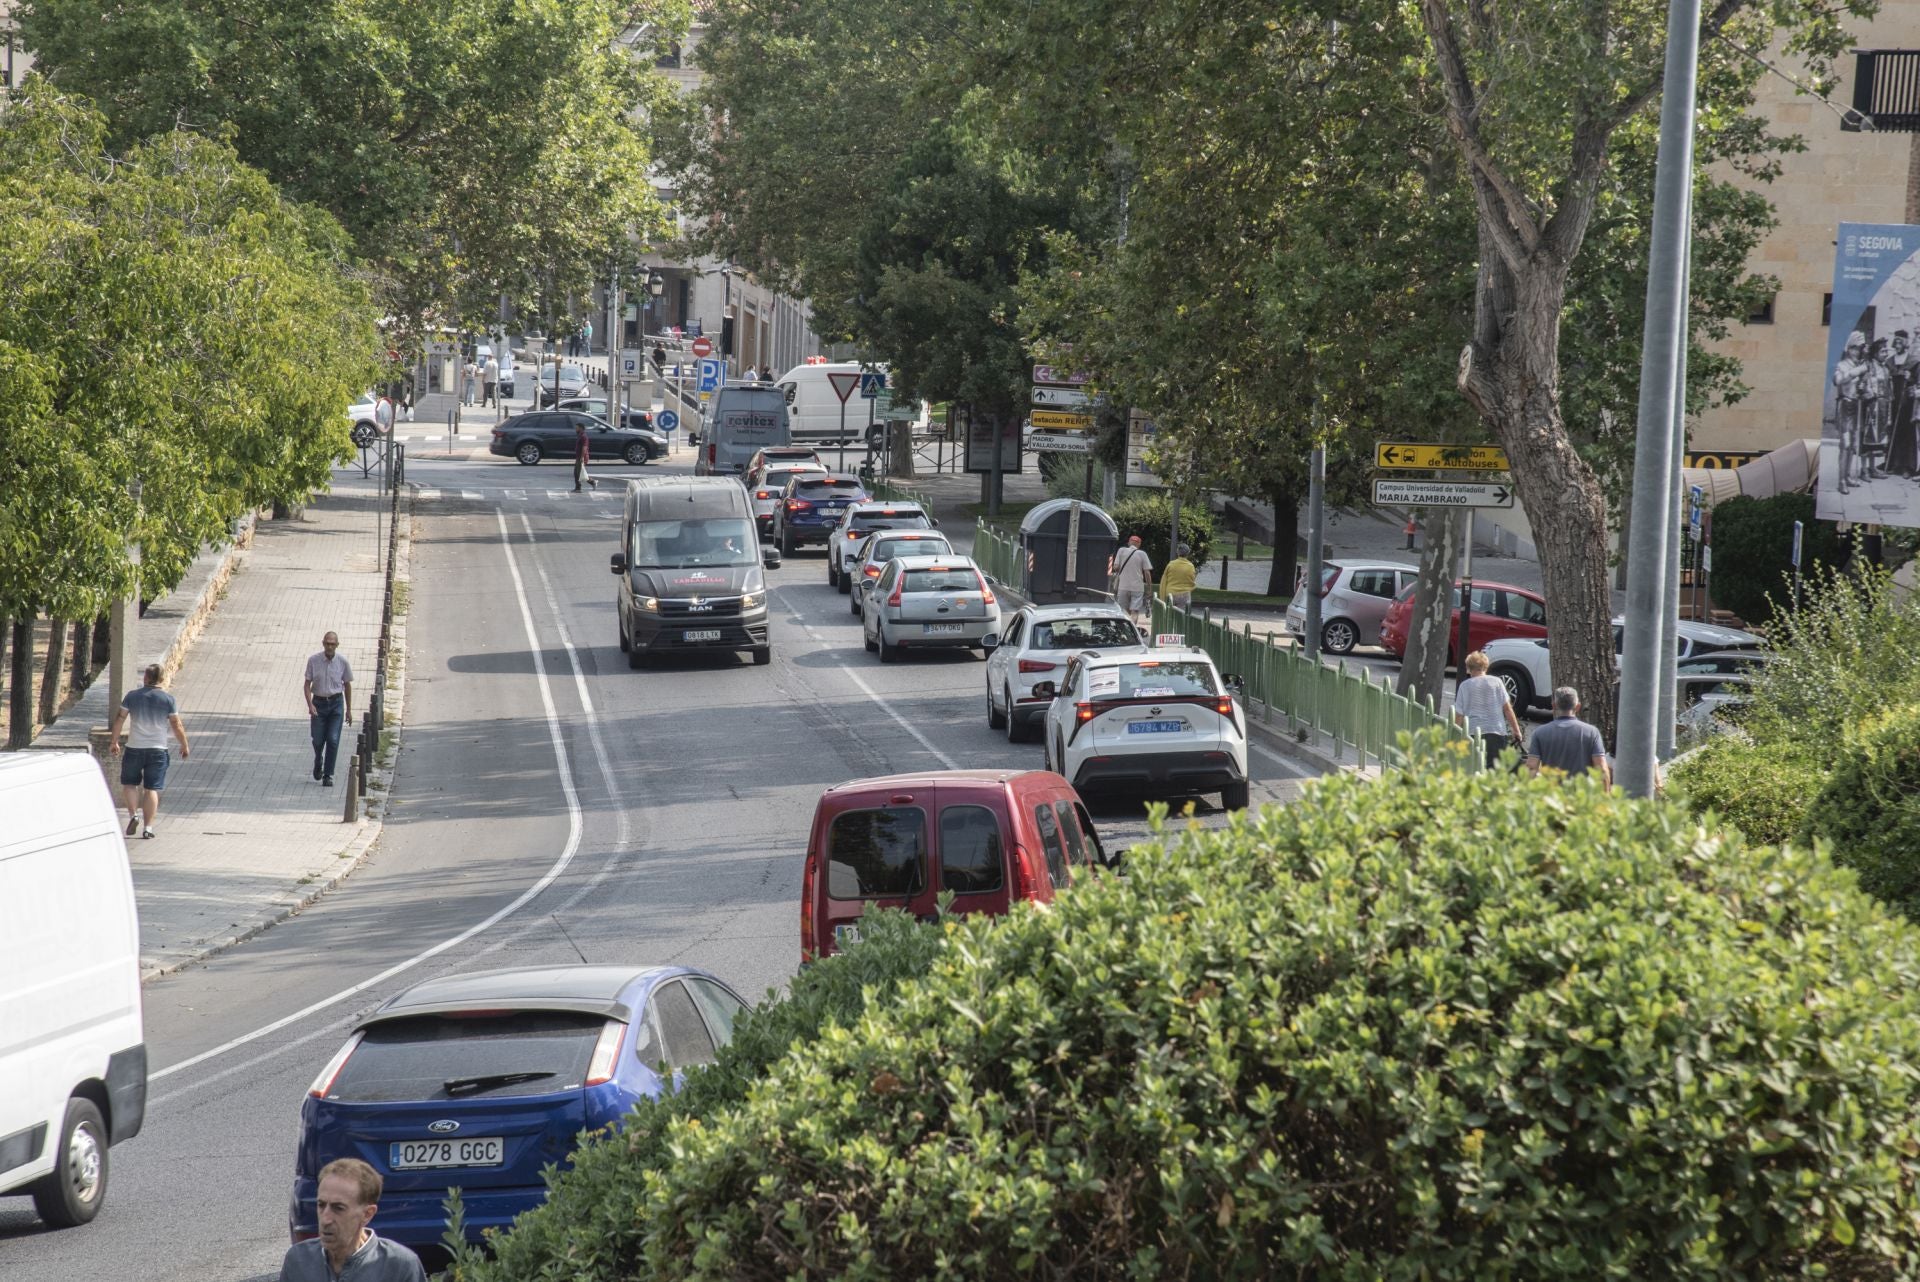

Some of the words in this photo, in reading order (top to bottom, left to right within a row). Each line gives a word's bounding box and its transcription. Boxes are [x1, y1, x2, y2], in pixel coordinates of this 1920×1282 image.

[1859, 236, 1903, 250] SEGOVIA
[702, 361, 716, 387] P
[728, 415, 775, 426] revitex
[1428, 458, 1441, 467] de
[1444, 459, 1499, 468] Autobuses
[1379, 483, 1405, 492] Campus
[1406, 484, 1444, 493] Universidad
[1445, 485, 1454, 493] de
[1454, 485, 1486, 494] Valladolid
[1379, 493, 1410, 502] MARIA
[1413, 494, 1467, 504] ZAMBRANO
[687, 631, 704, 639] 0818
[1165, 634, 1180, 642] TAXI
[1134, 723, 1158, 732] 6784
[434, 1122, 453, 1130] Ford
[404, 1143, 452, 1163] 0278
[460, 1141, 497, 1161] GGC
